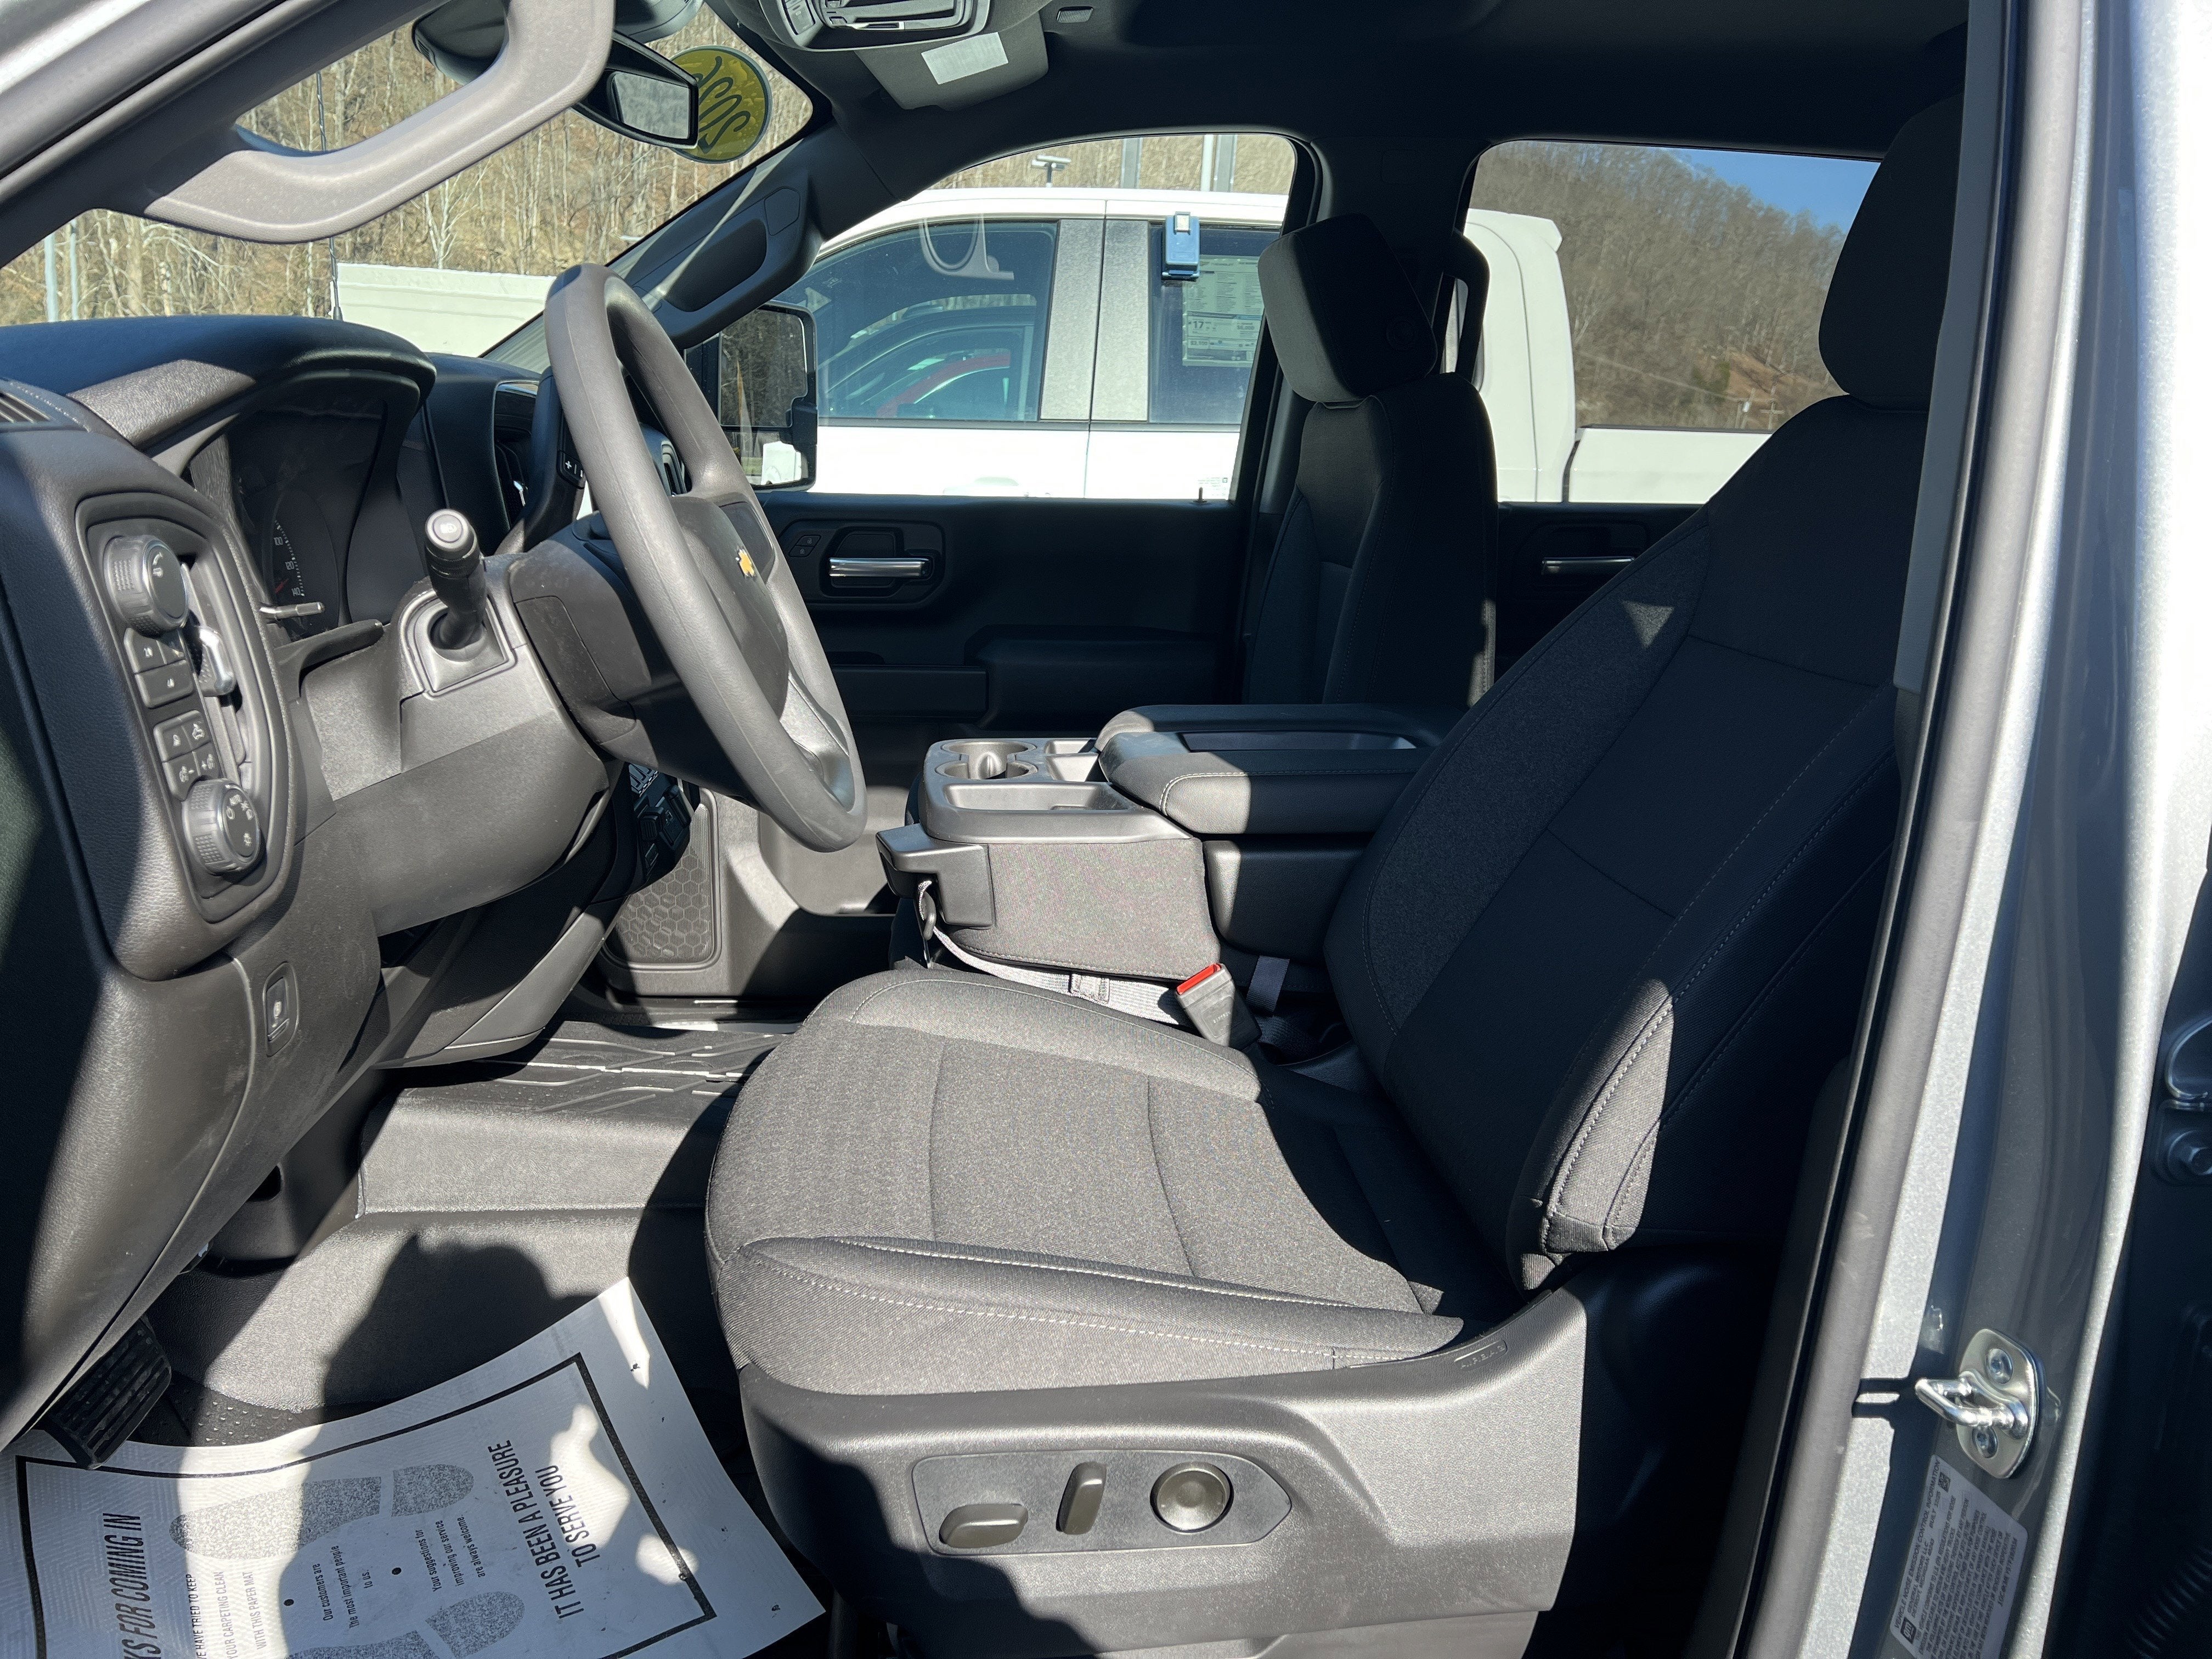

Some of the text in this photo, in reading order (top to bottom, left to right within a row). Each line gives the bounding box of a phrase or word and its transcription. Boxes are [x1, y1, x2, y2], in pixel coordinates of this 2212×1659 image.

[103, 1513, 142, 1531] IN
[488, 1440, 584, 1619] IT HAS BEEN A PLEASURE
[535, 1465, 600, 1568] TO SERVE YOU
[330, 1545, 346, 1567] people
[435, 1520, 465, 1587] improving our service
[467, 1544, 481, 1566] always
[1895, 1460, 1940, 1628] VEHICLE NOISE EMISSION CONTROL INFORMATION
[104, 1534, 150, 1602] COMING
[415, 1530, 442, 1592] Your suggestions for
[475, 1566, 486, 1578] are
[185, 1573, 197, 1592] KEEP
[213, 1571, 227, 1594] CLEAN
[312, 1563, 334, 1621] Our customers are
[335, 1566, 352, 1599] important
[363, 1581, 373, 1589] to
[188, 1594, 199, 1603] TO
[242, 1571, 267, 1650] WITH THIS PAPER MAT
[343, 1598, 357, 1615] most
[115, 1603, 158, 1639] FOR
[190, 1606, 202, 1628] TRIED
[217, 1595, 234, 1637] CARPETING
[193, 1629, 206, 1650] HAVE
